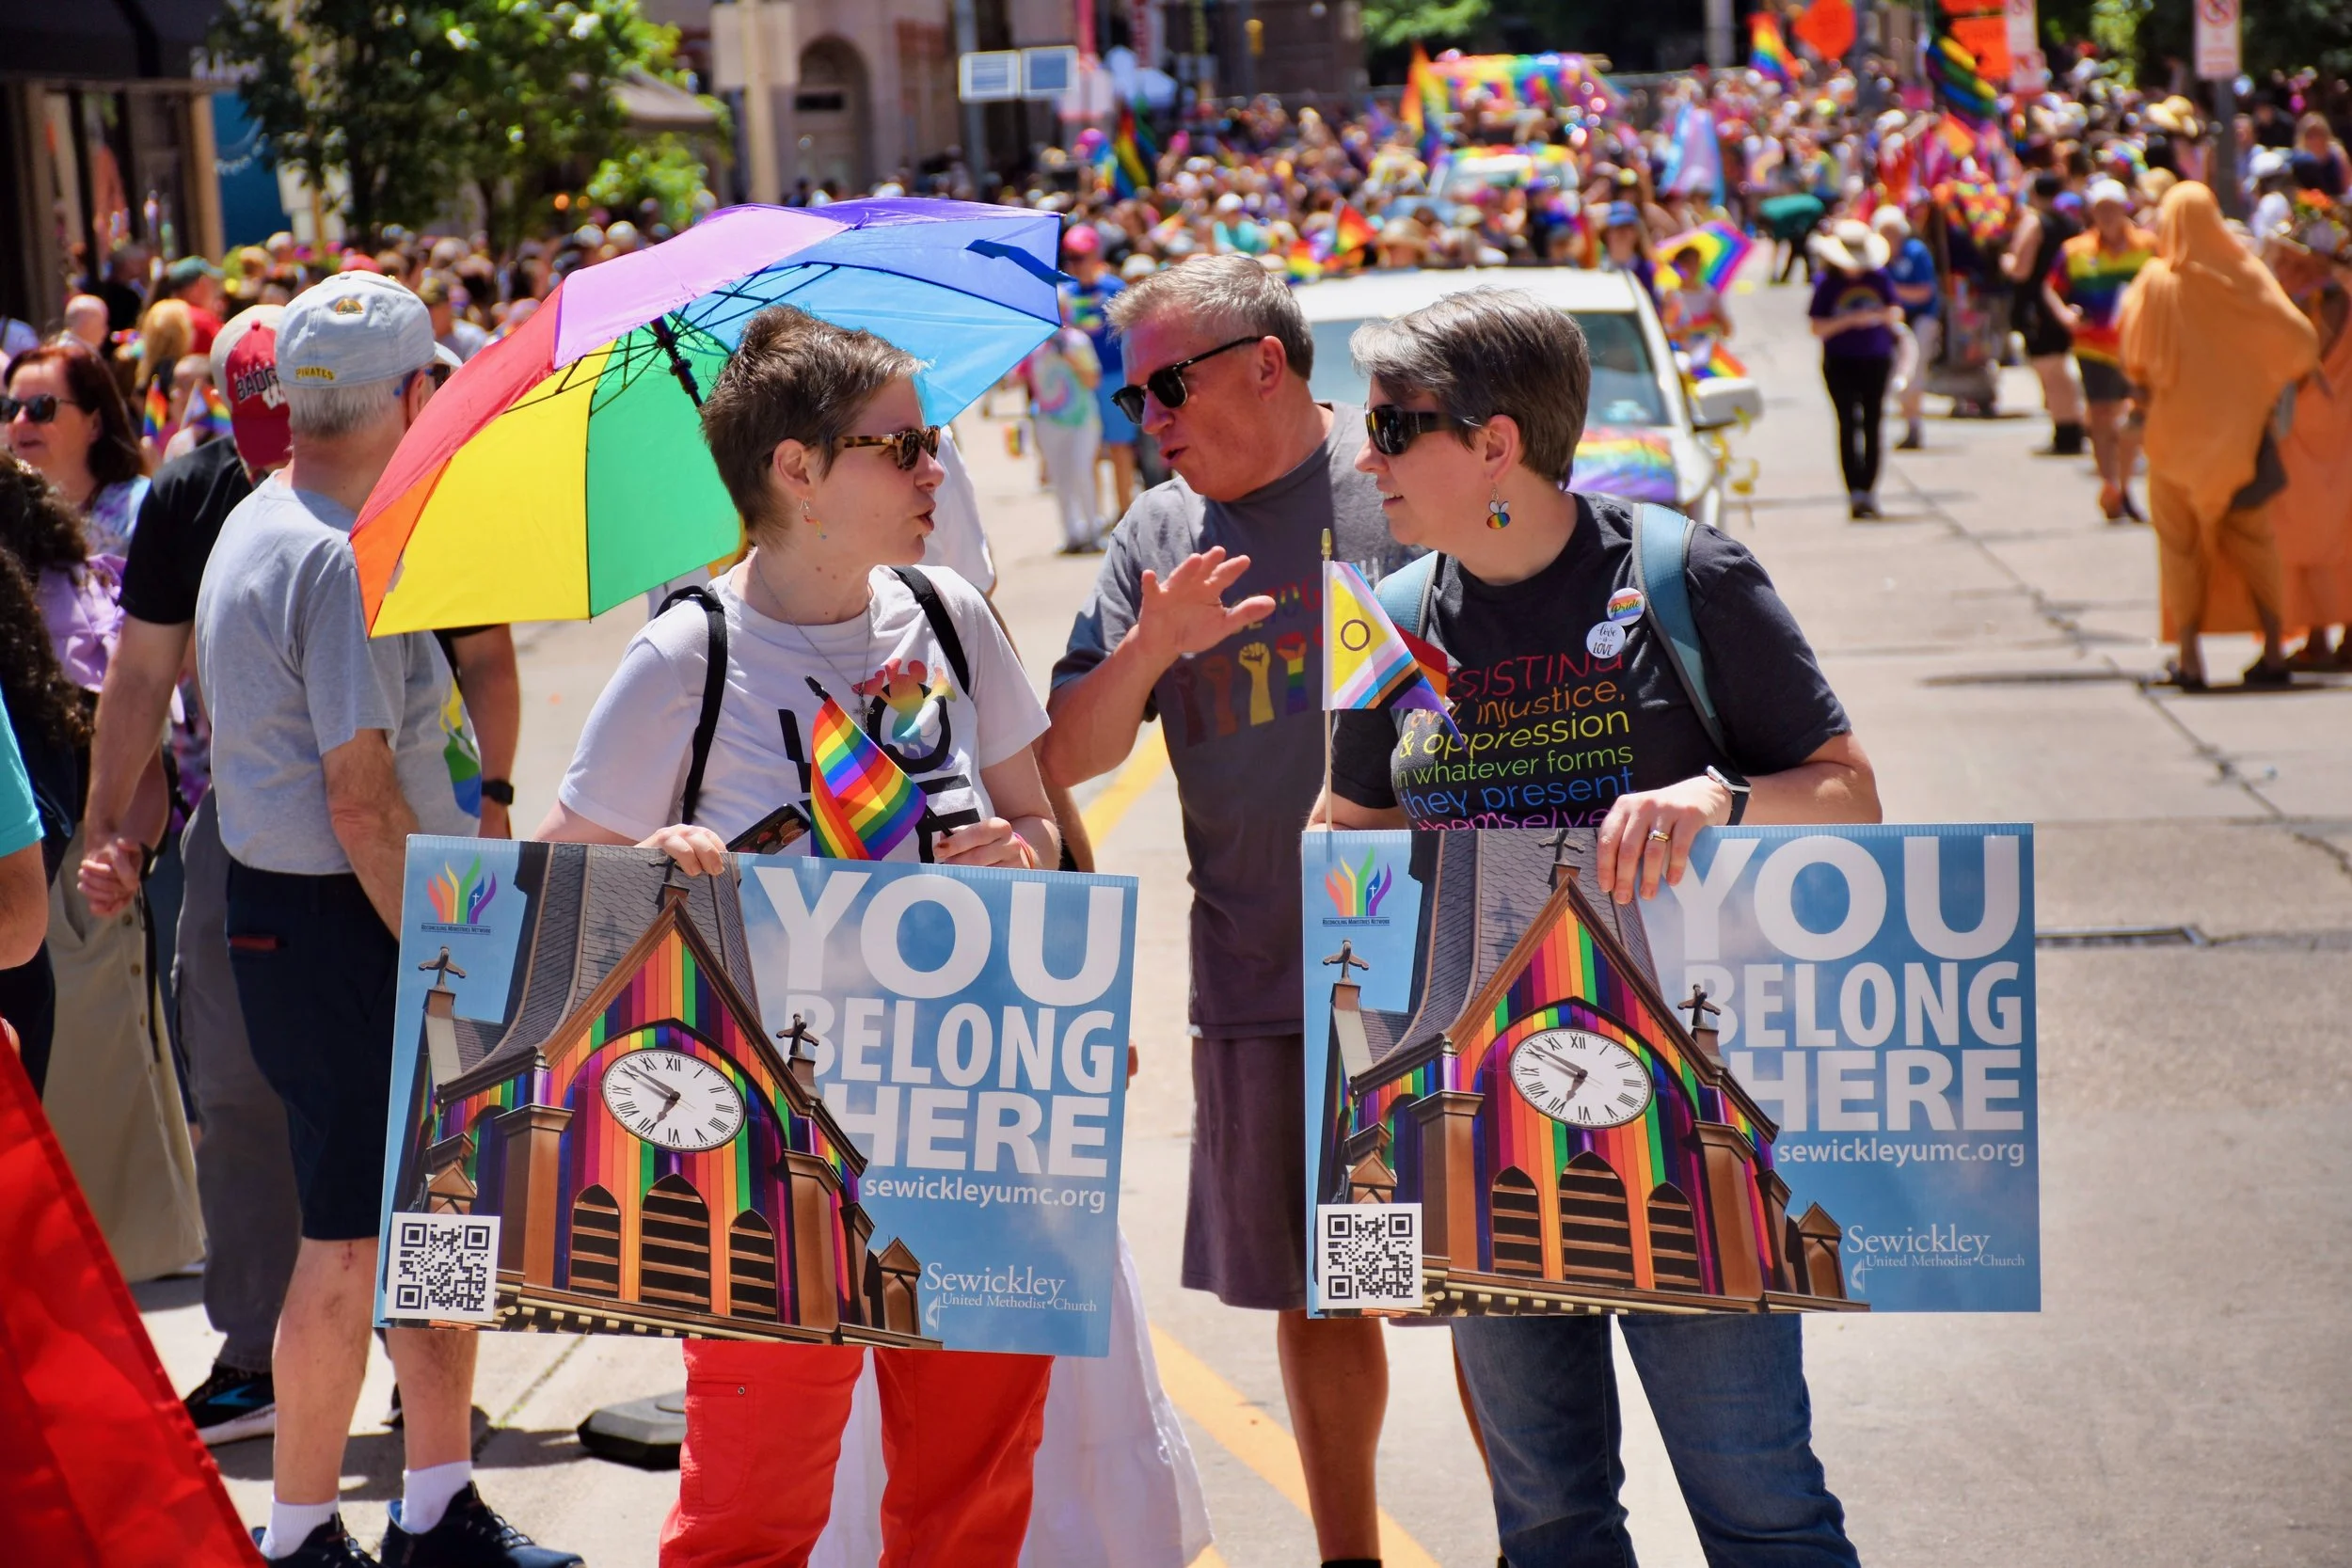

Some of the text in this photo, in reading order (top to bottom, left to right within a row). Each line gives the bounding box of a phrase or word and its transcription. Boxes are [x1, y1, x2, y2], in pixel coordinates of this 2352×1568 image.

[295, 366, 335, 381] PIRATES
[1611, 599, 1641, 617] Pride
[1593, 641, 1613, 656] LOVE
[1474, 680, 1627, 729] injustice,
[1399, 710, 1630, 761] & oppression
[1412, 757, 1540, 785] whatever
[1547, 745, 1634, 774] forms
[1400, 765, 1637, 819] they present
[1669, 834, 2021, 961] YOU
[753, 866, 1124, 1006] YOU
[1684, 961, 2022, 1048] BELONG
[783, 994, 1116, 1094] BELONG
[1729, 1050, 2024, 1132] HERE
[823, 1084, 1110, 1178] HERE
[1778, 1137, 2025, 1166] sewickleyumc.org
[865, 1175, 1105, 1213] sewickleyumc.org
[1847, 1224, 1991, 1260] Sewickley
[1866, 1253, 2025, 1267] United Methodist Church
[924, 1261, 1066, 1305] Sewickley
[942, 1292, 1097, 1312] United Methodist Church
